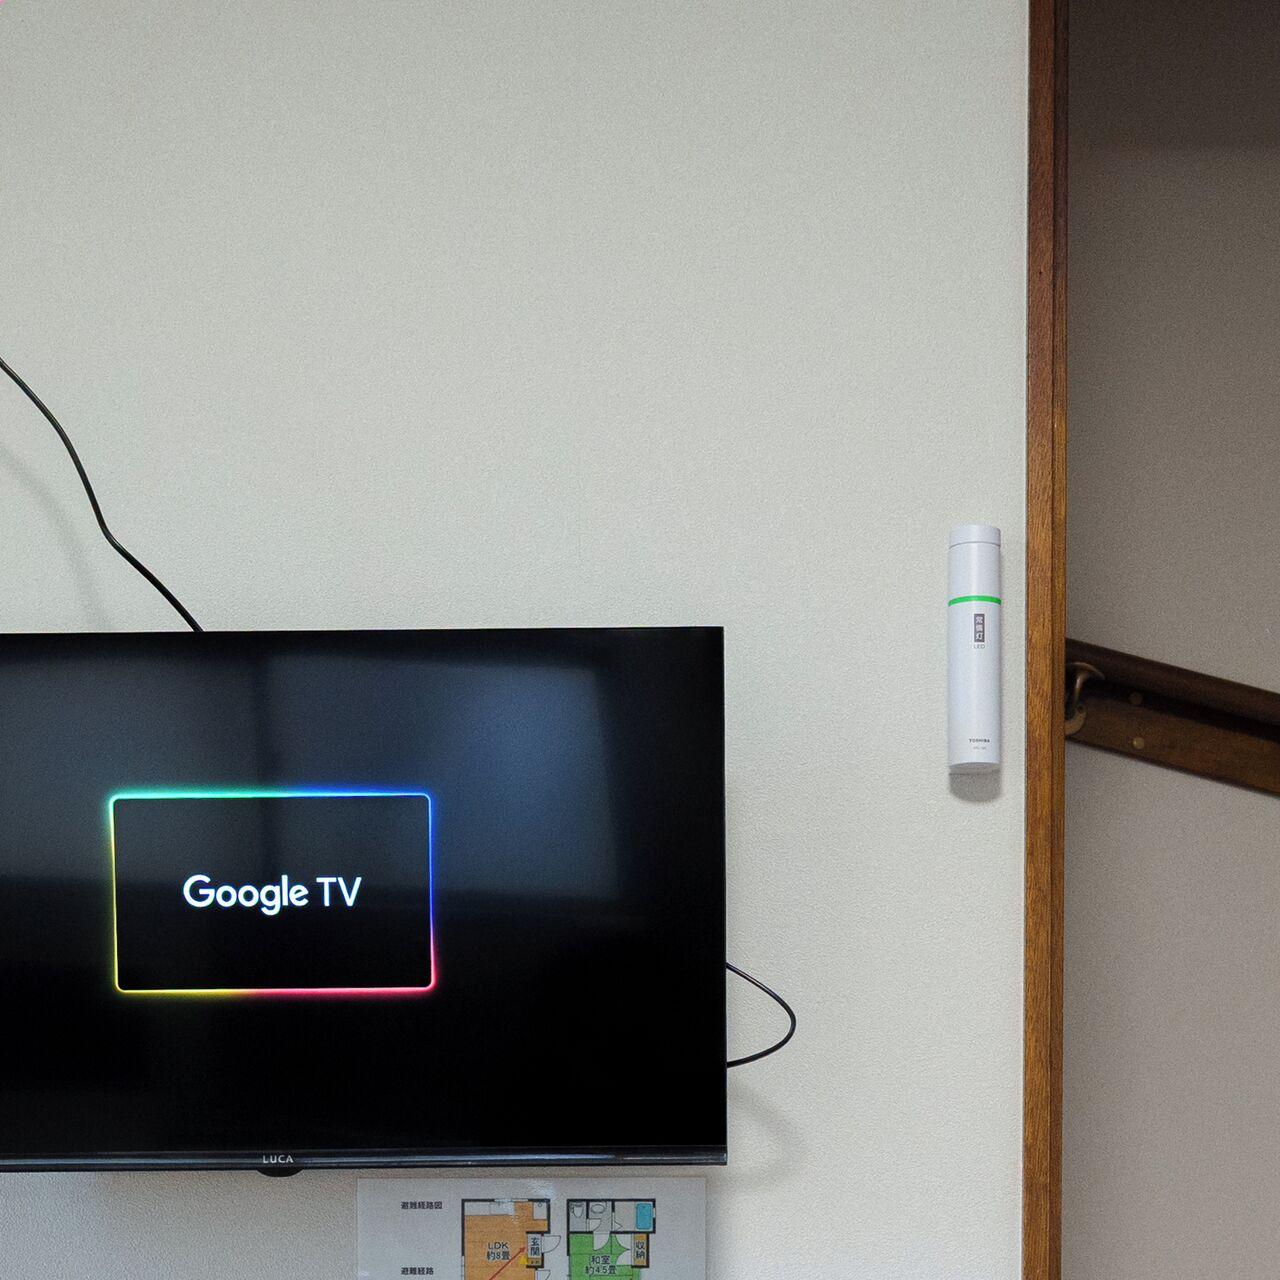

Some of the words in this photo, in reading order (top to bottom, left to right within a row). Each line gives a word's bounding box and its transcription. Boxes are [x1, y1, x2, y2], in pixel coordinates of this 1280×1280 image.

[183, 874, 309, 916] Google
[316, 876, 362, 907] TV
[262, 1154, 294, 1164] LUCA
[401, 1201, 443, 1210] 避難経路図
[488, 1241, 509, 1250] LDK
[530, 1237, 540, 1256] 玄関
[635, 1241, 645, 1259] 収納
[487, 1251, 510, 1261] 約8畳
[591, 1255, 610, 1265] 和室
[401, 1267, 434, 1275] 避難経路
